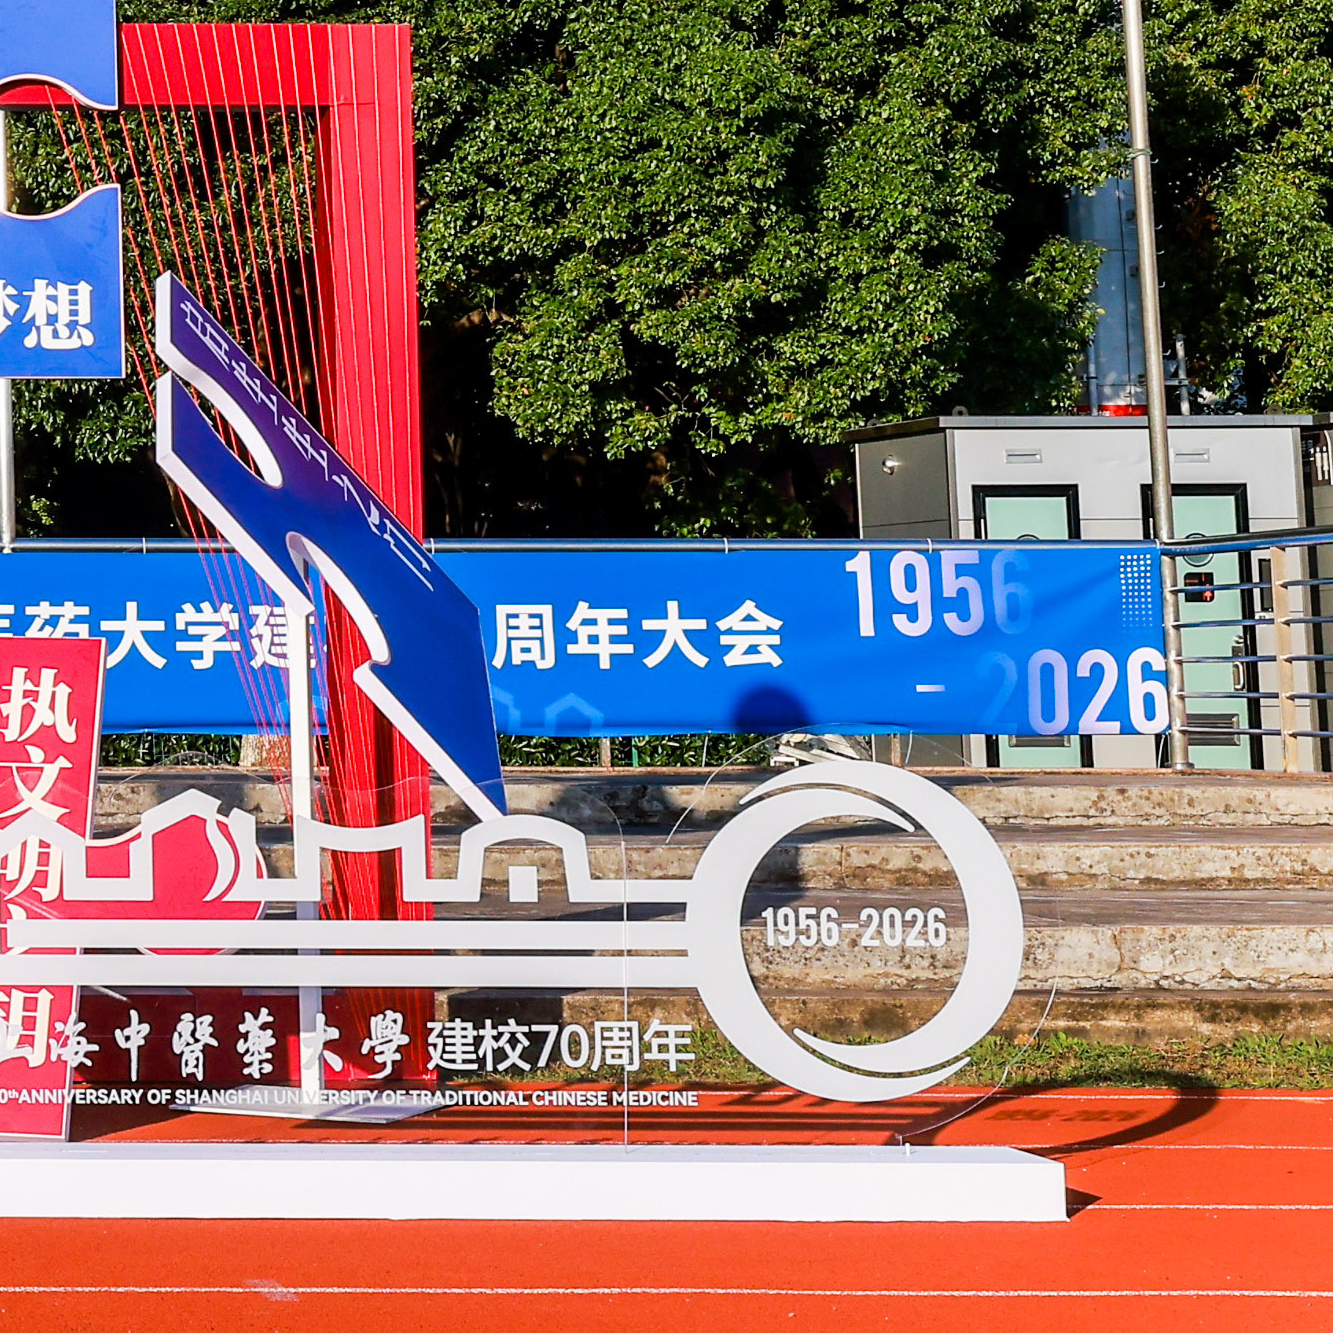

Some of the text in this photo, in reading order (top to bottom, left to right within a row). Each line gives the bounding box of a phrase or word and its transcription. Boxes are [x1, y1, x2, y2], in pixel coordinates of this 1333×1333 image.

[180, 300, 434, 592] 启生生之门
[845, 549, 1031, 637] 1956
[761, 906, 948, 948] 1956-2026
[426, 1018, 696, 1071] 建校70周年
[147, 1089, 172, 1104] OF
[175, 1089, 268, 1105] SHANGHAI
[382, 1090, 408, 1105] OF
[409, 1090, 529, 1106] TRADITIONAL
[531, 1090, 609, 1106] CHINESE
[612, 1090, 698, 1107] MEDICINE
